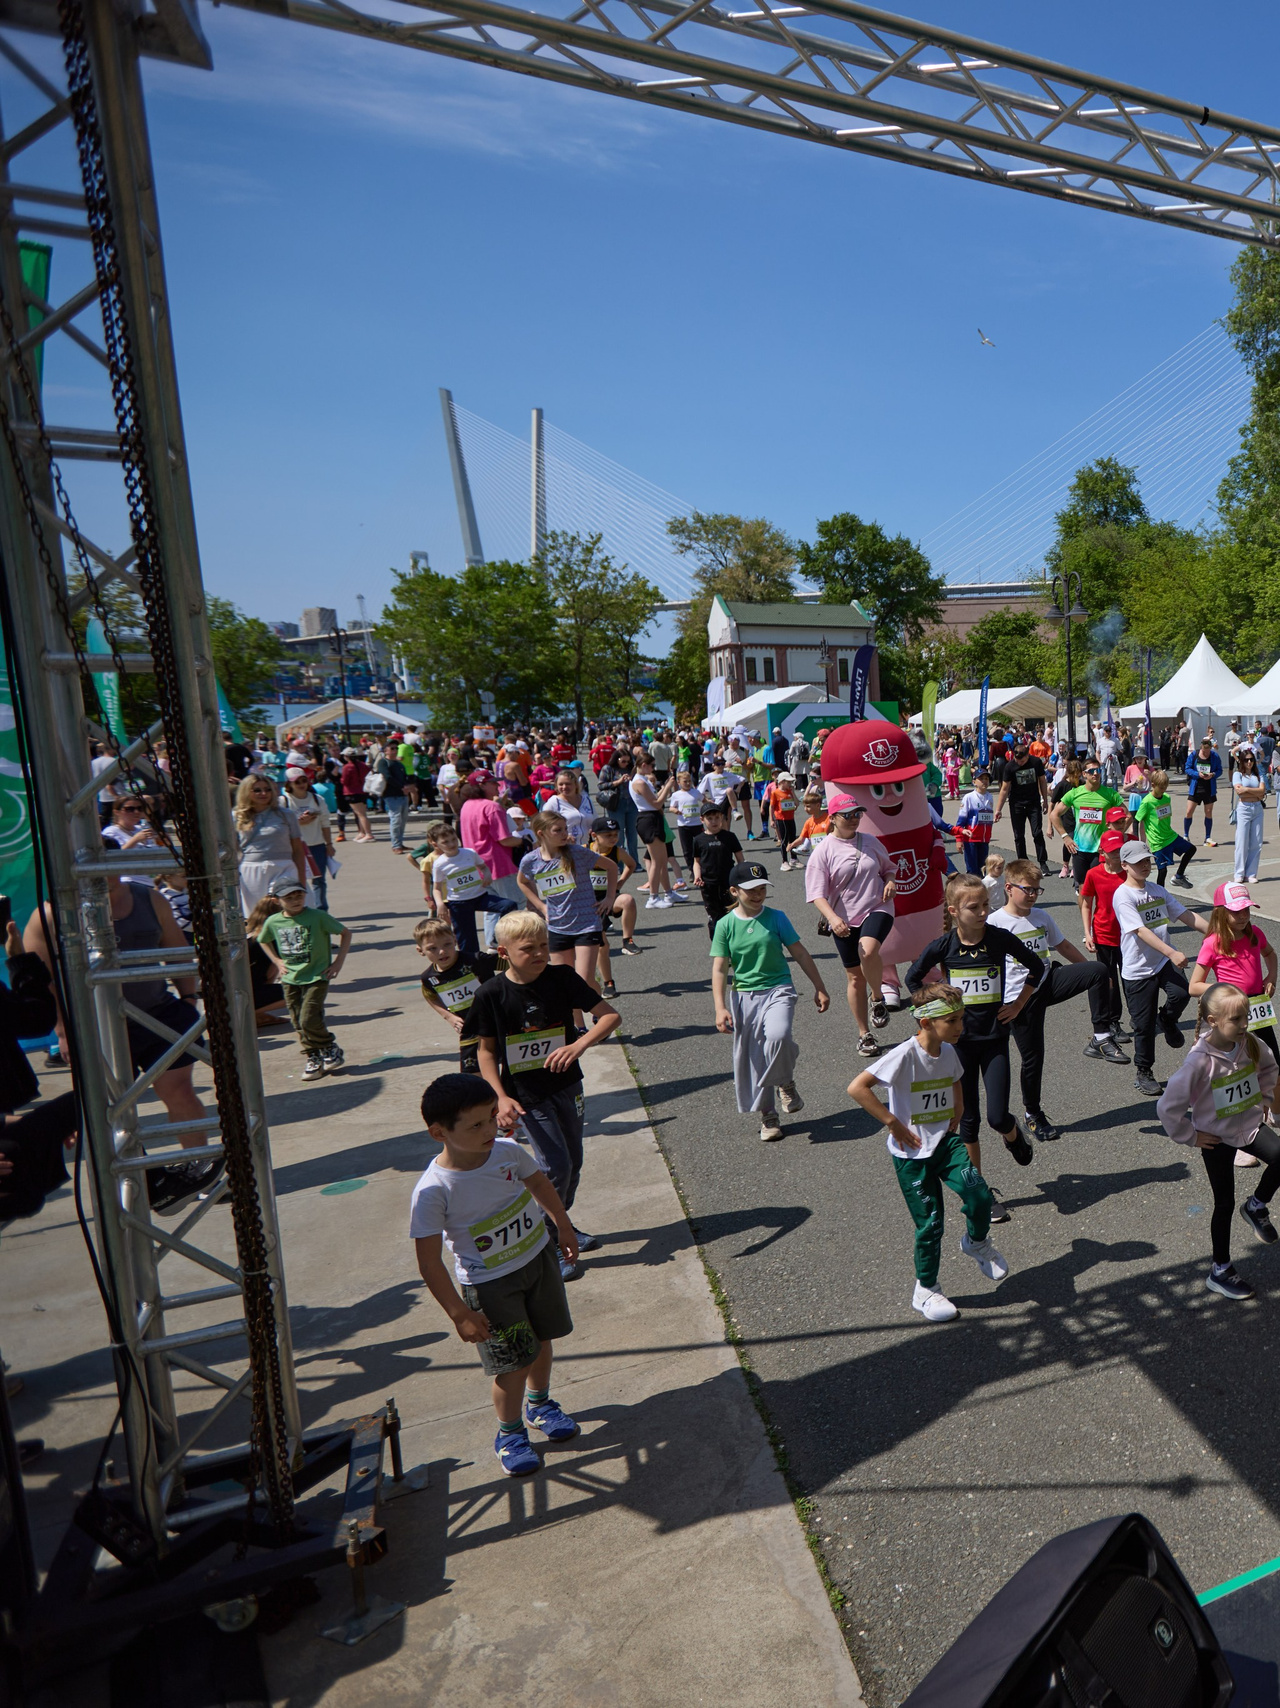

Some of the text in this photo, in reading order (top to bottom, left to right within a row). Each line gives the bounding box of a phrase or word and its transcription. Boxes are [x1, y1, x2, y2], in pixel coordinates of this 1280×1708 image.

[456, 874, 474, 885] 826
[545, 875, 565, 887] 719
[895, 876, 922, 891] АТИМИР
[1145, 908, 1161, 922] 824
[428, 976, 440, 986] 10
[962, 978, 990, 993] 715
[447, 986, 473, 1002] 734
[519, 1040, 551, 1060] 787
[1225, 1080, 1252, 1103] 713
[922, 1091, 947, 1110] 716
[494, 1211, 533, 1247] 776
[498, 1247, 520, 1261] 420м
